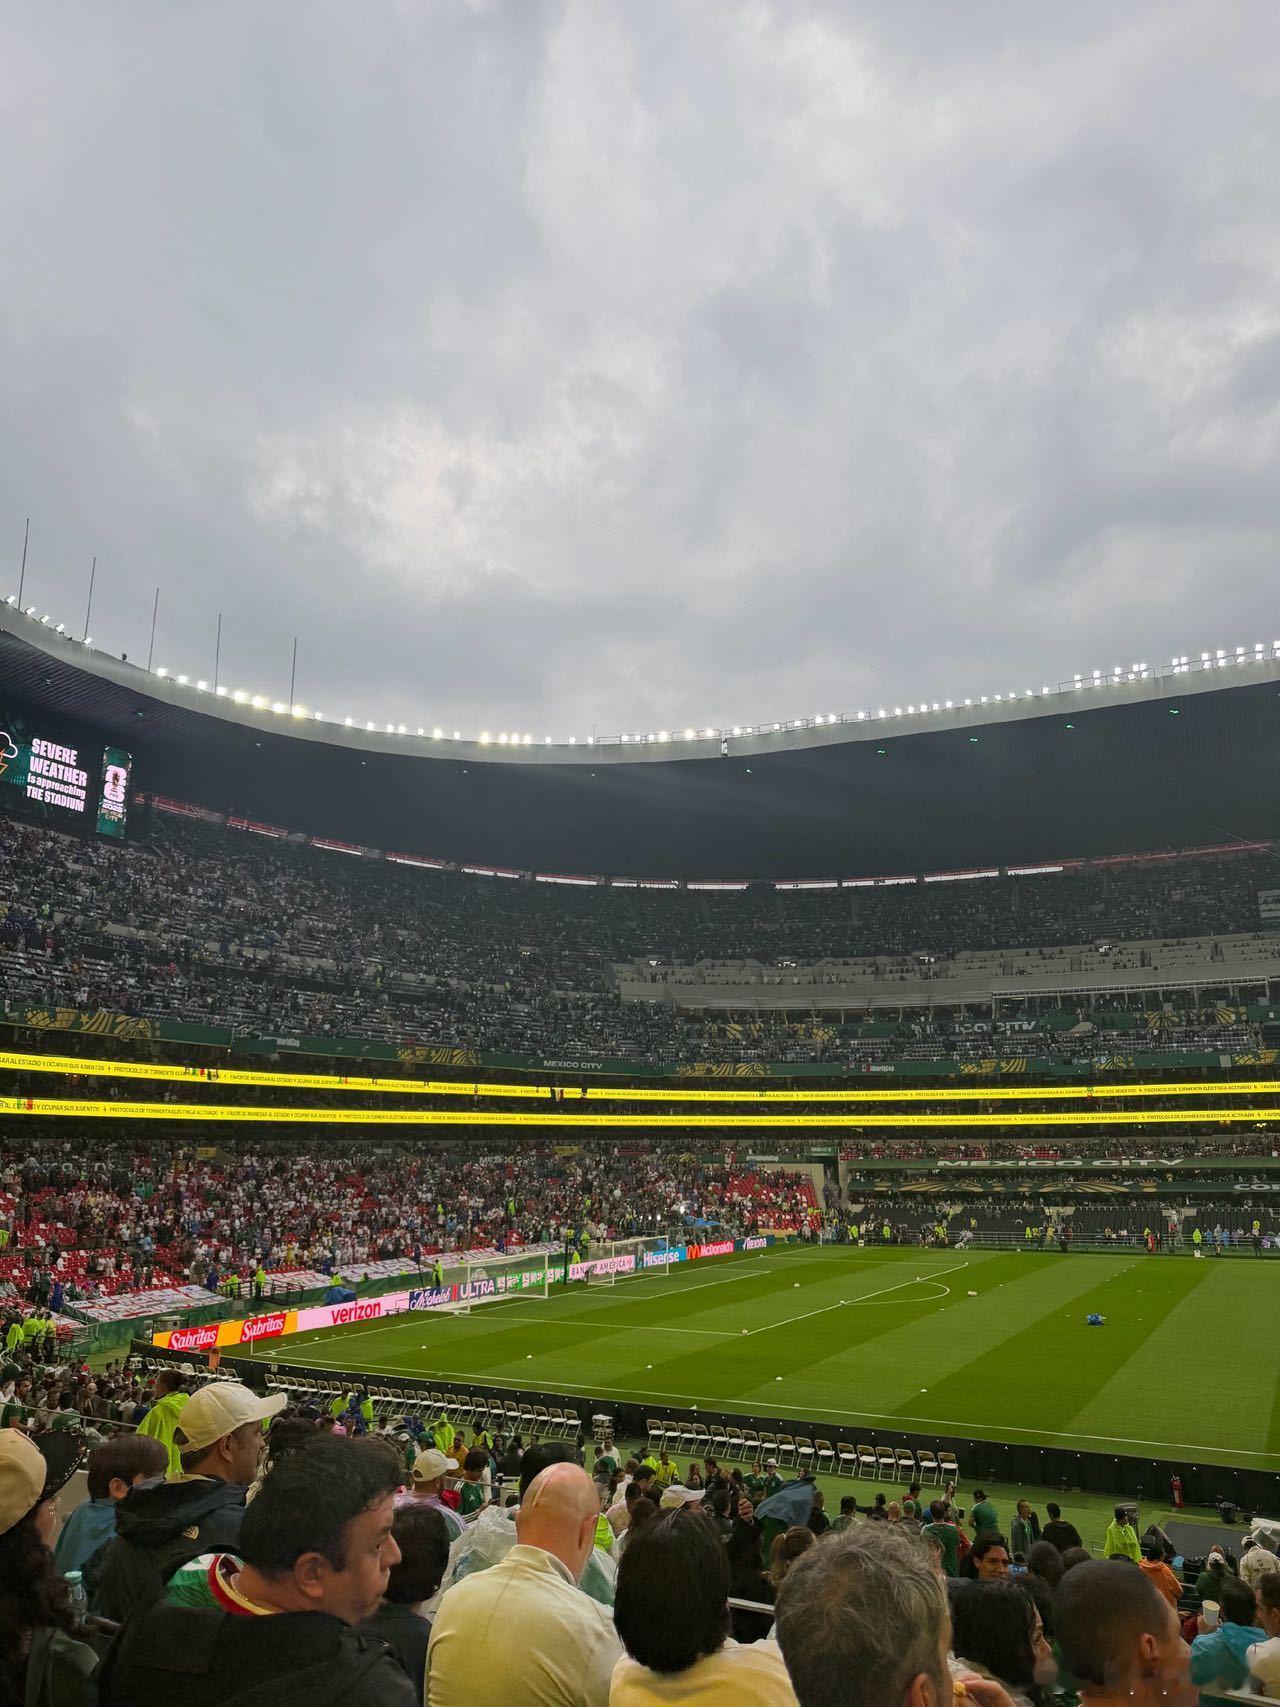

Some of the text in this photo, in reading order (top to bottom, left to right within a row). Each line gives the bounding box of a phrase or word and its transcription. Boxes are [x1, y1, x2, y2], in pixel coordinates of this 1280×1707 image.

[32, 738, 78, 766] SEVERE
[30, 756, 88, 787] WEATHER
[26, 785, 44, 800] THE
[44, 790, 84, 812] STADIUM
[544, 1060, 579, 1068] MEXICO
[1092, 1158, 1184, 1166] CITY
[700, 1241, 734, 1256] McDonald's
[746, 1238, 766, 1250] Rexona
[600, 1260, 626, 1272] AMERICA
[643, 1250, 680, 1268] Hisense
[460, 1280, 494, 1299] ULTRA
[331, 1302, 381, 1325] verizon
[242, 1318, 284, 1340] Sabritas
[169, 1330, 217, 1351] Sabritas
